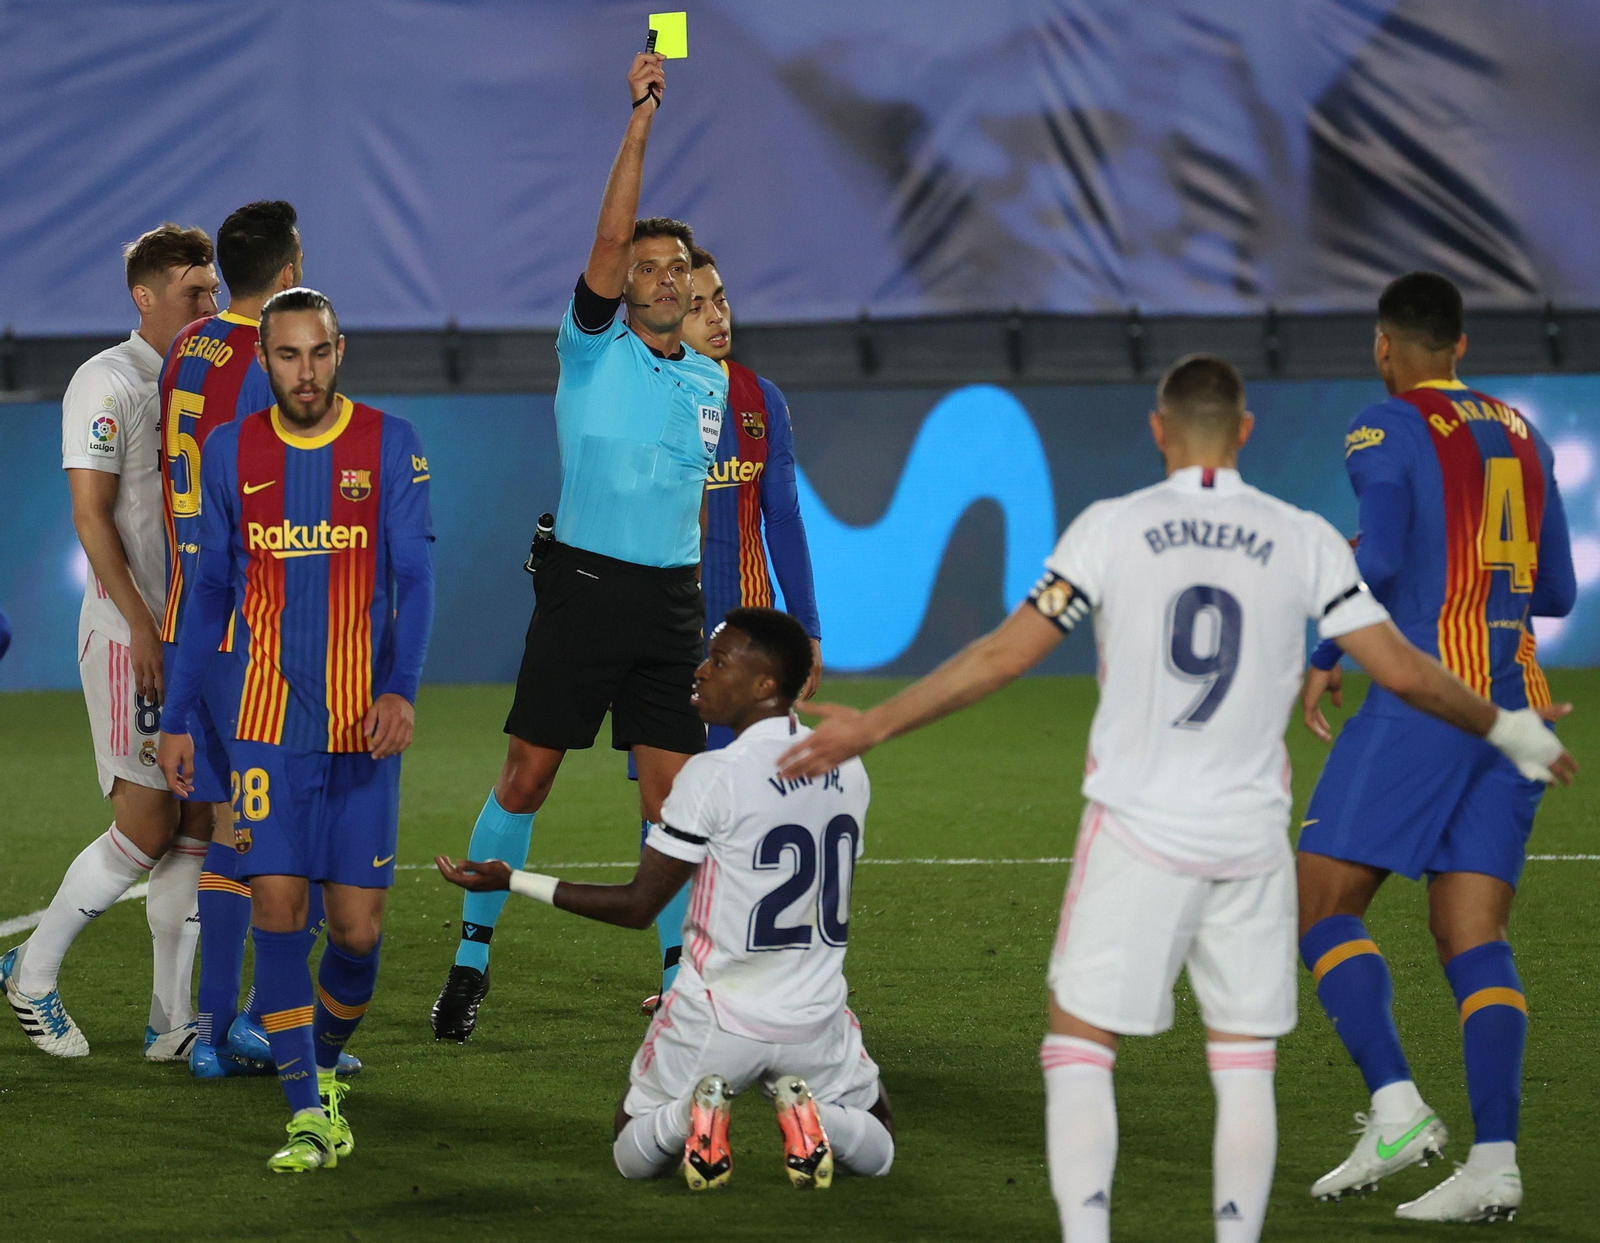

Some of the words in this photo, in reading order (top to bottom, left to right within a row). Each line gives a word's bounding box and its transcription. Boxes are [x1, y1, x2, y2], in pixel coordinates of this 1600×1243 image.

[176, 335, 234, 368] SERGIO
[702, 408, 720, 423] FIFA
[702, 426, 719, 437] REFEREE
[1428, 413, 1460, 437] R.
[89, 442, 115, 453] LaLiga
[166, 388, 206, 518] 5
[706, 456, 764, 482] uten
[248, 519, 368, 551] Rakuten
[1144, 518, 1275, 567] BENZEMA
[1477, 457, 1538, 593] 4
[1164, 584, 1243, 731] 9
[134, 685, 161, 736] 8
[231, 767, 270, 821] 28
[746, 813, 859, 953] 20
